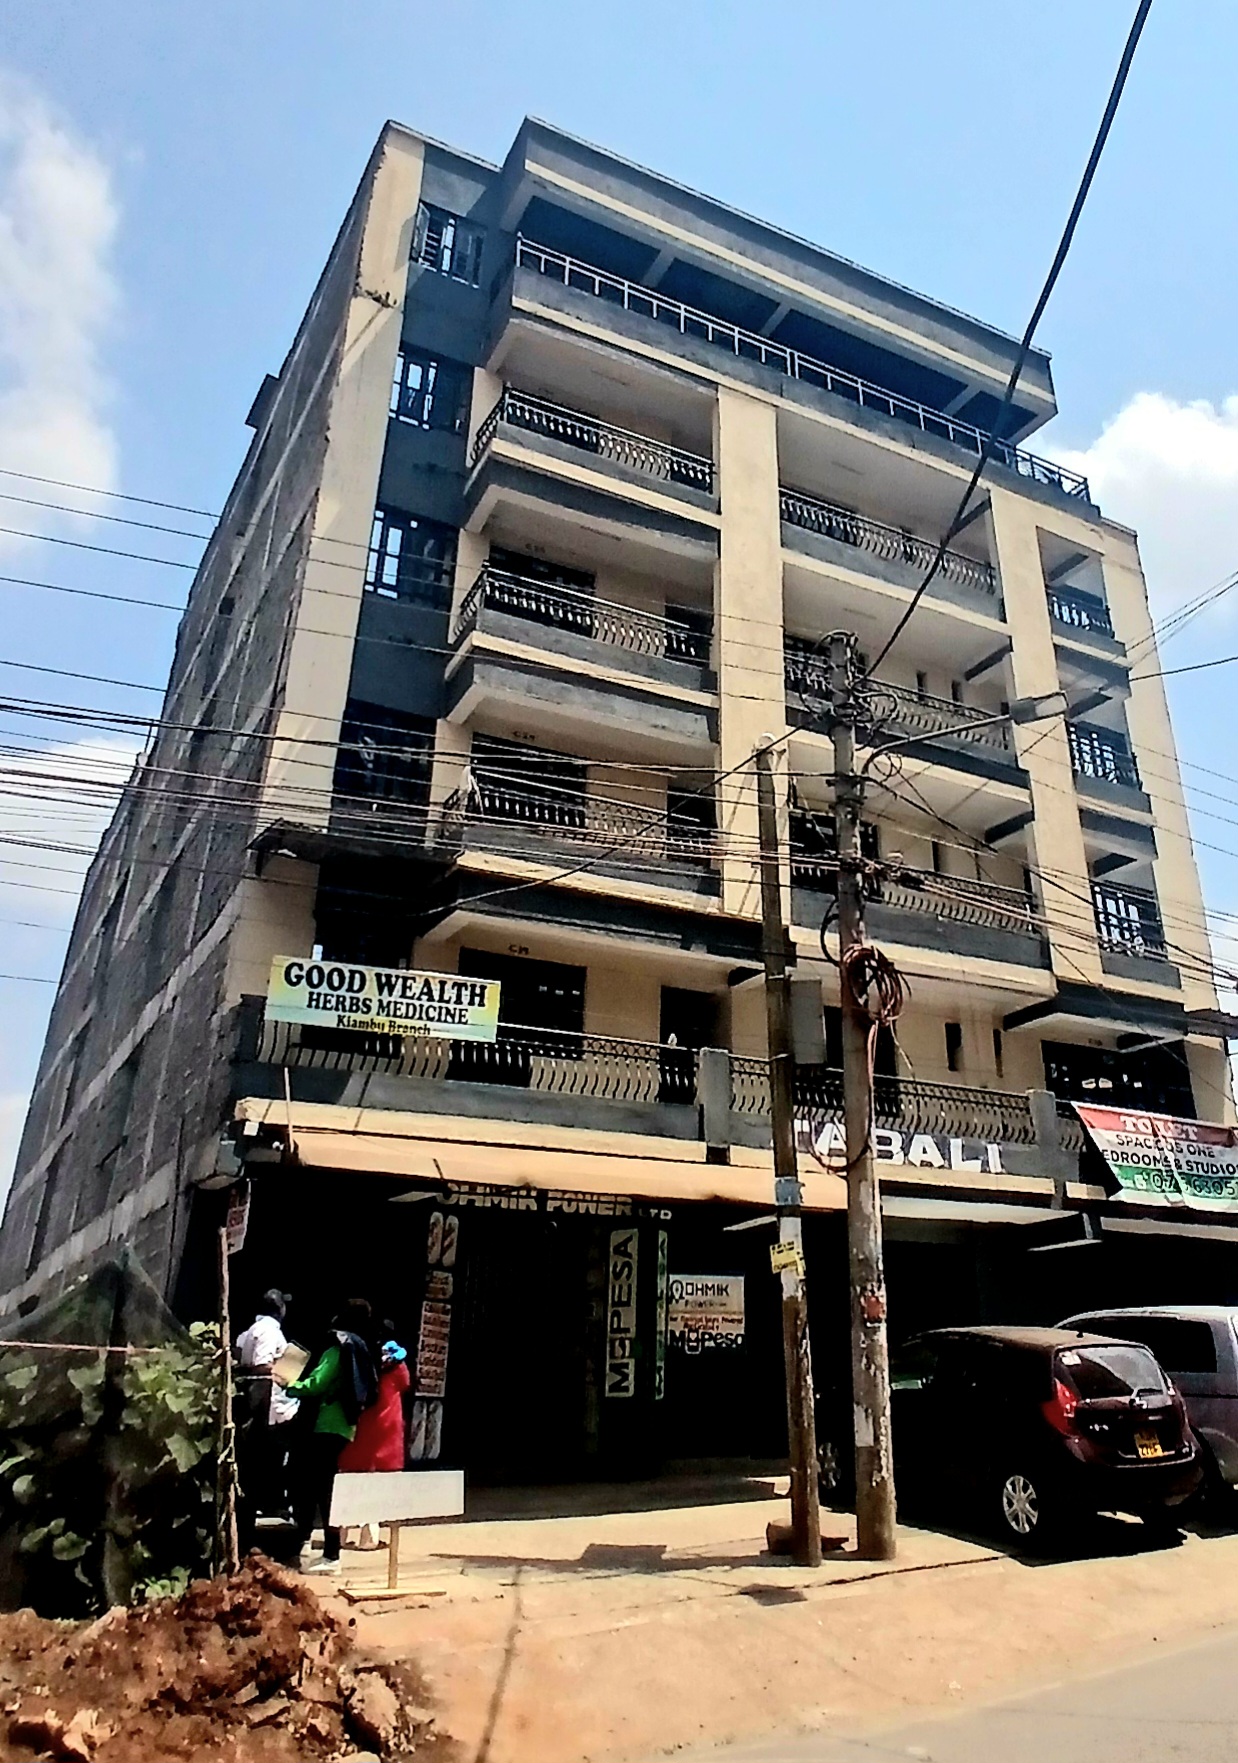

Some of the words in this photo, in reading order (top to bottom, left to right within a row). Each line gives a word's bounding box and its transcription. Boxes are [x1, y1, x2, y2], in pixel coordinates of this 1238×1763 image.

[284, 962, 367, 993] GOOD
[374, 972, 488, 1007] WEALTH
[306, 991, 371, 1015] HERBS
[376, 1001, 469, 1025] MEDICINE
[336, 1015, 386, 1033] Kiambu
[388, 1021, 431, 1036] Branch
[1187, 1144, 1216, 1158] ONE
[1186, 1160, 1238, 1175] STUDIO
[547, 1191, 632, 1215] POWER
[685, 1282, 730, 1297] OHMIK
